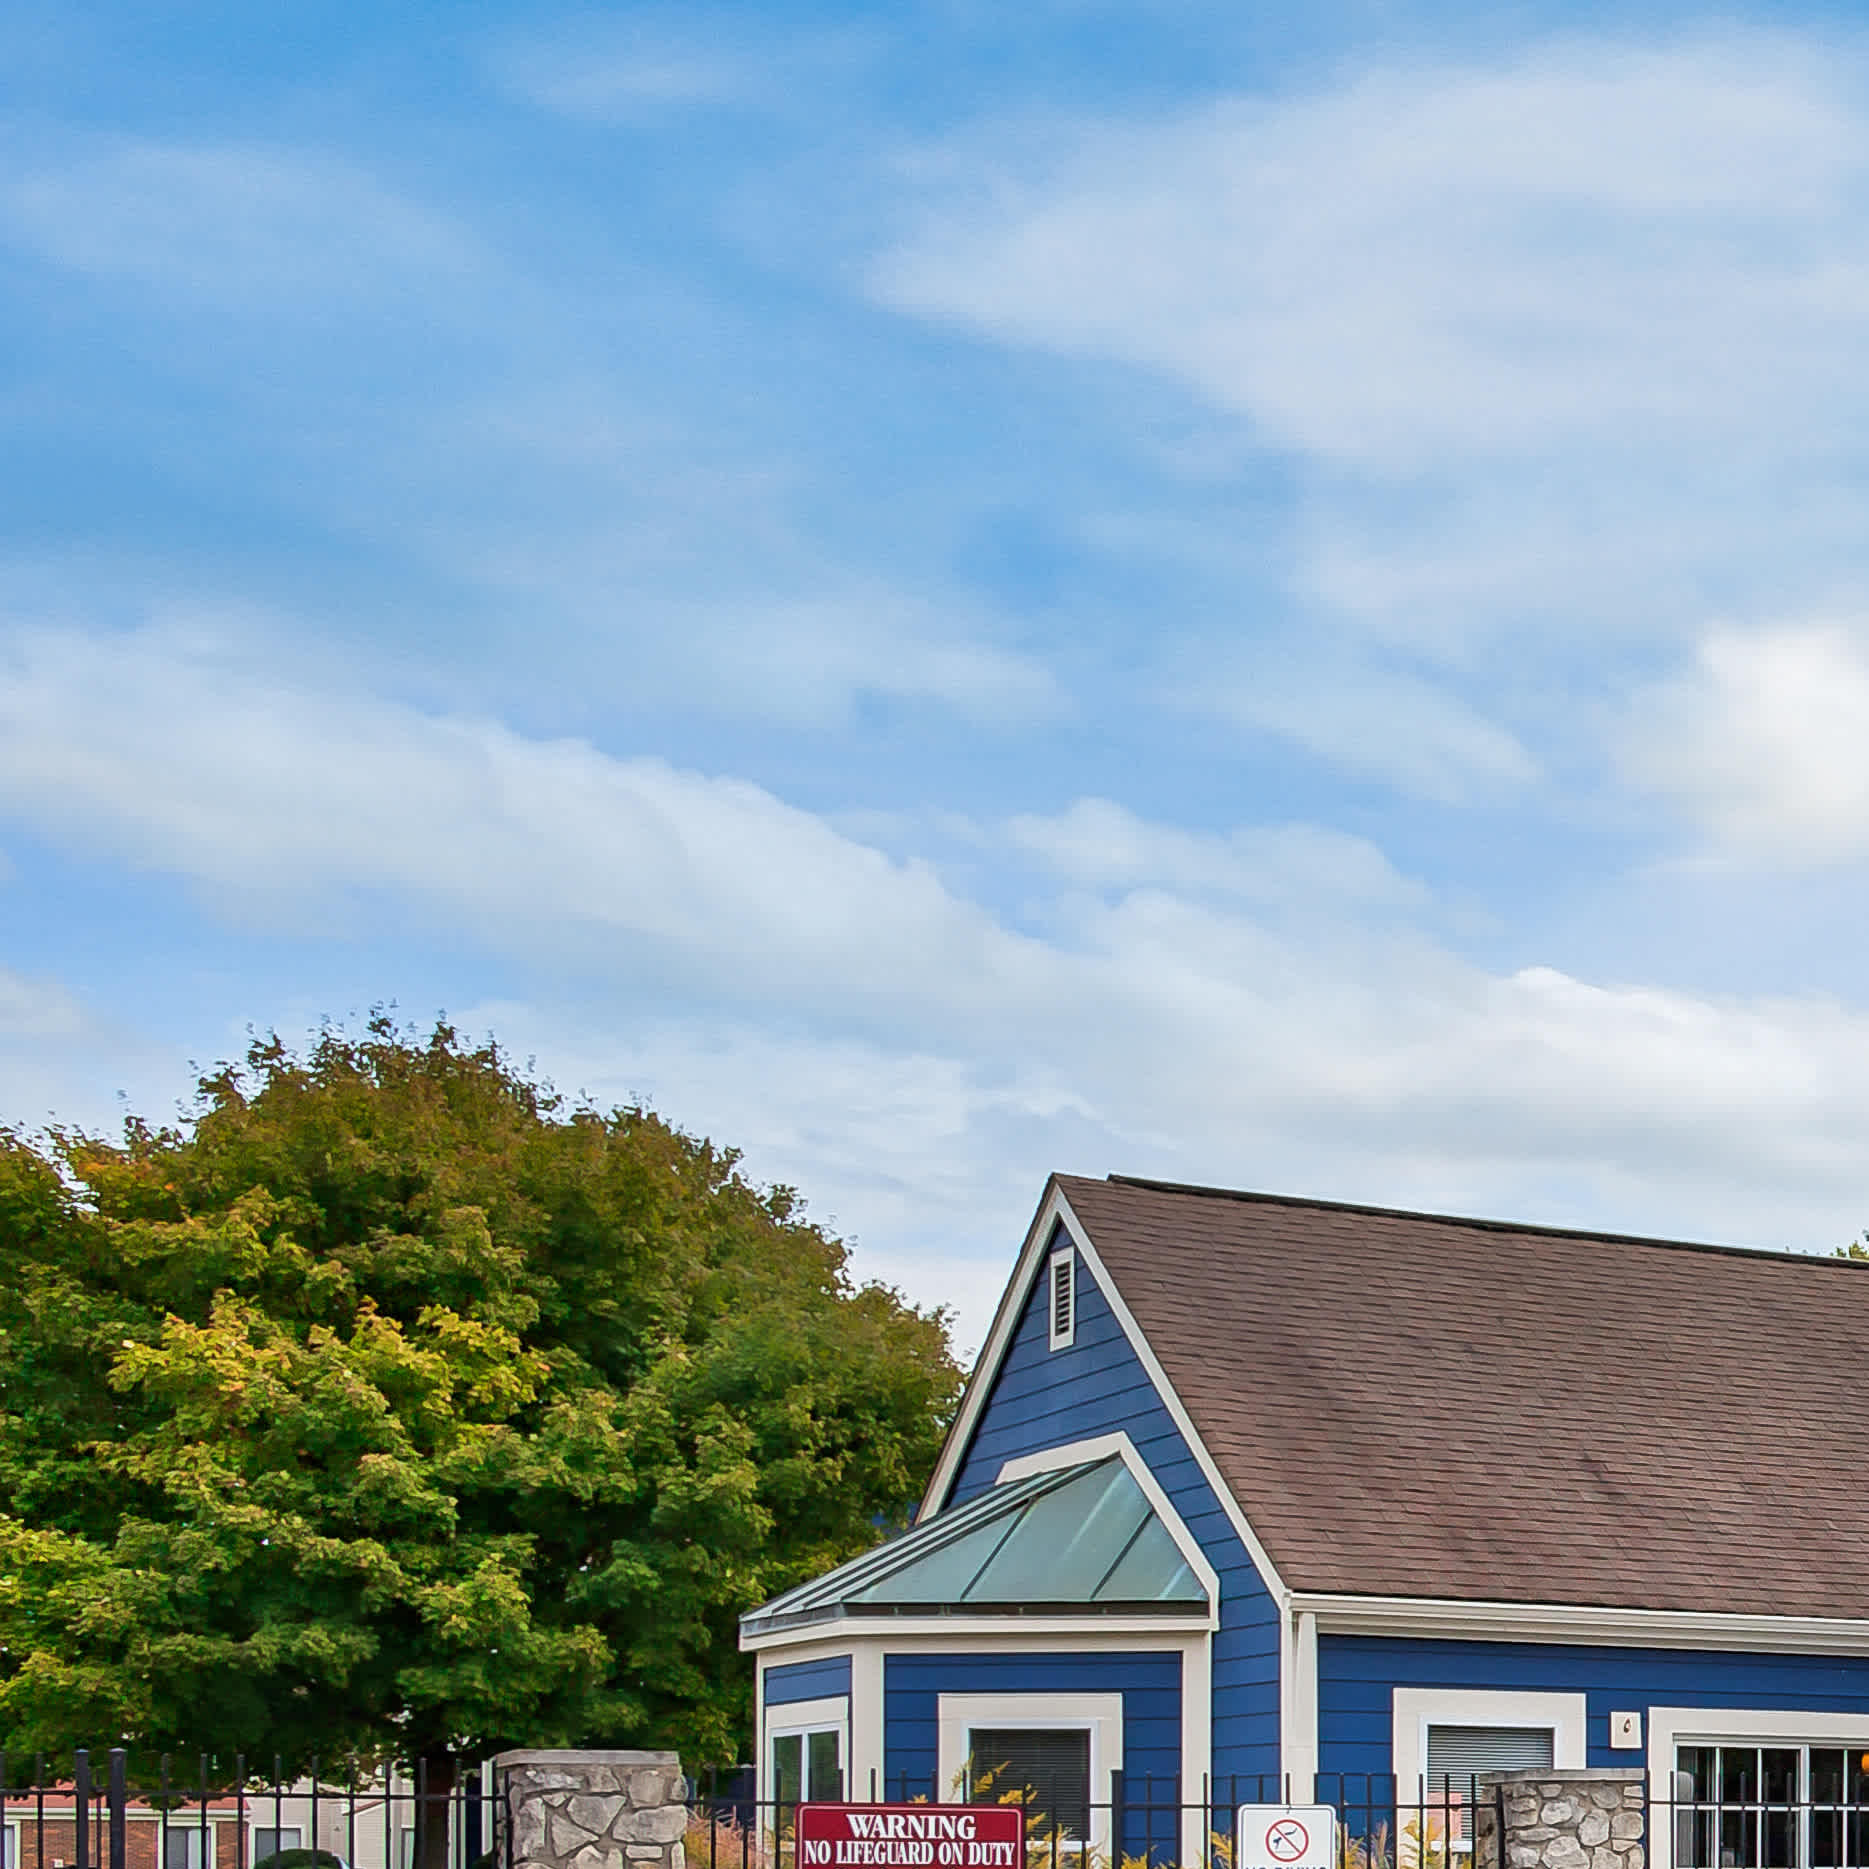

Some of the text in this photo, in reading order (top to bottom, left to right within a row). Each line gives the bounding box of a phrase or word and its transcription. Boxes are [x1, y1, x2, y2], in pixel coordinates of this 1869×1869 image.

[846, 1813, 977, 1840] WARNING
[804, 1840, 1015, 1866] NO LIFEGUARD ON DUTY
